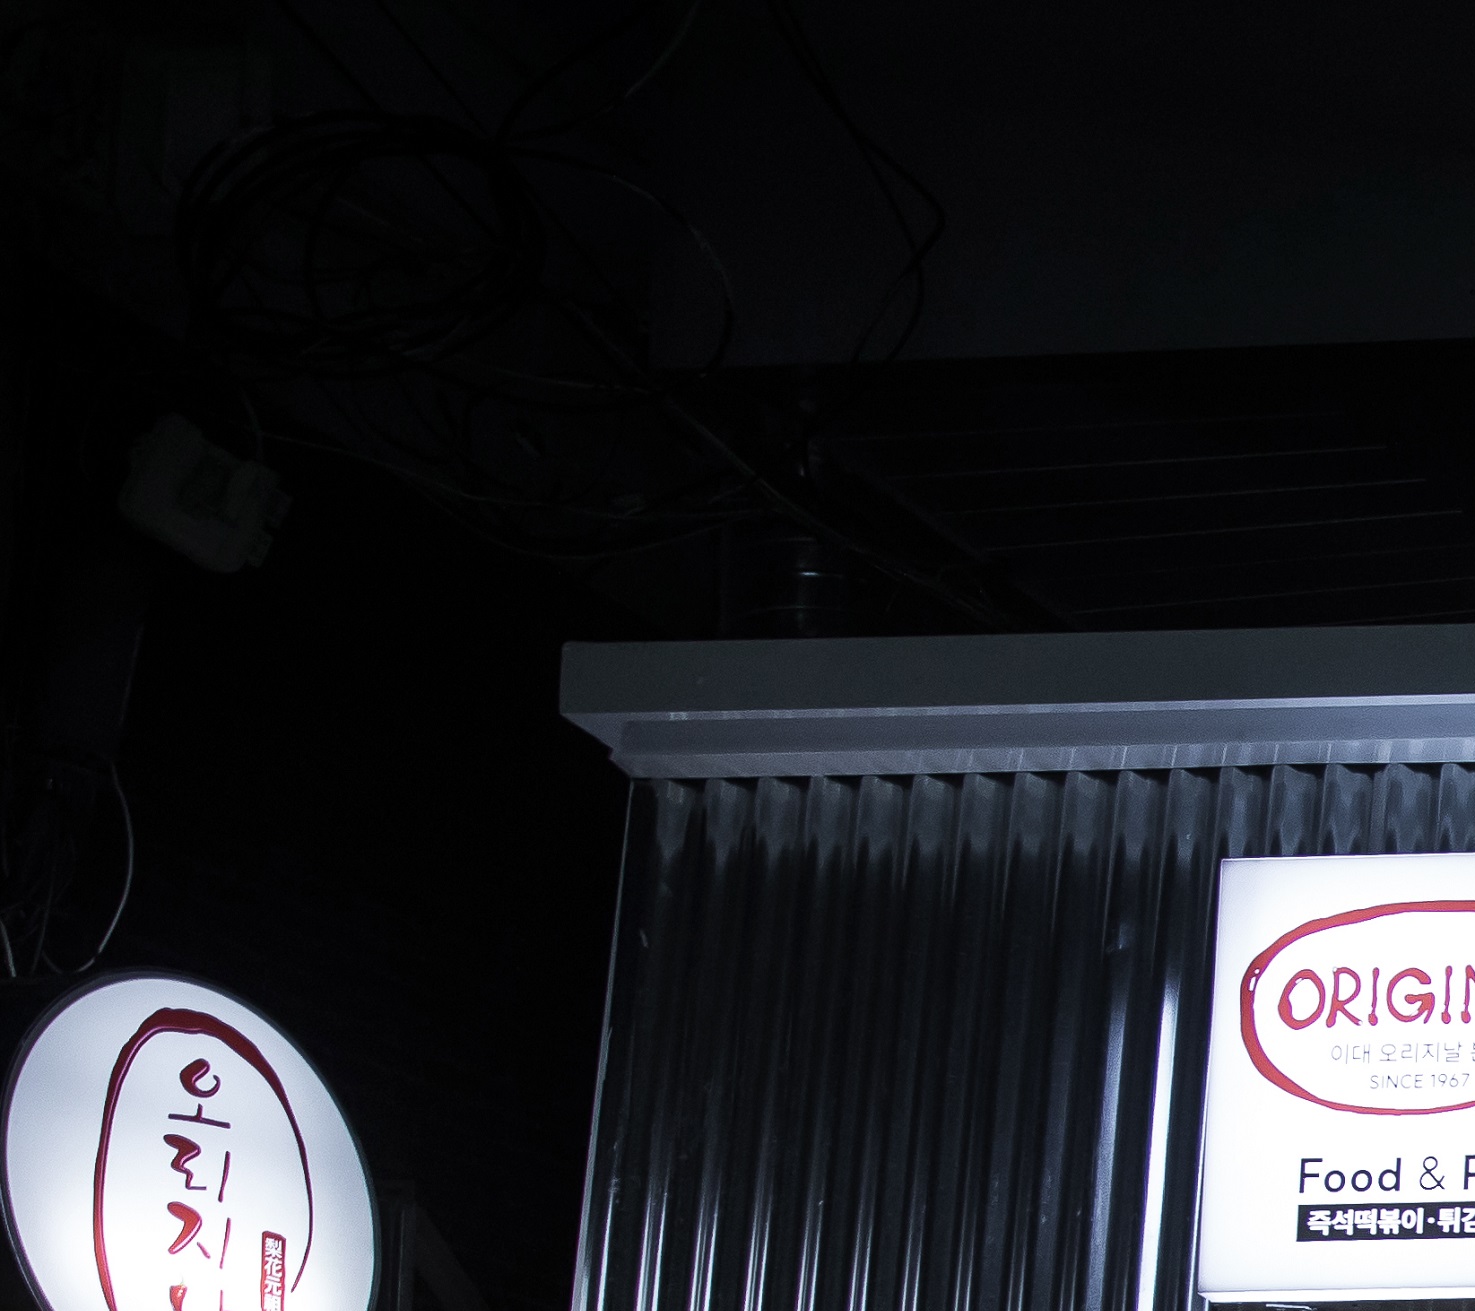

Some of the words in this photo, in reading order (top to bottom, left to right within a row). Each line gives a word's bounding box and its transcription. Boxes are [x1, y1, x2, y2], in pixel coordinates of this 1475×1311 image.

[1331, 1042, 1371, 1064] 이대
[1379, 1041, 1463, 1064] 오리지날
[1369, 1073, 1424, 1090] SINCE
[1431, 1072, 1470, 1089] 1967
[1299, 1156, 1402, 1194] Food
[1419, 1156, 1446, 1191] &
